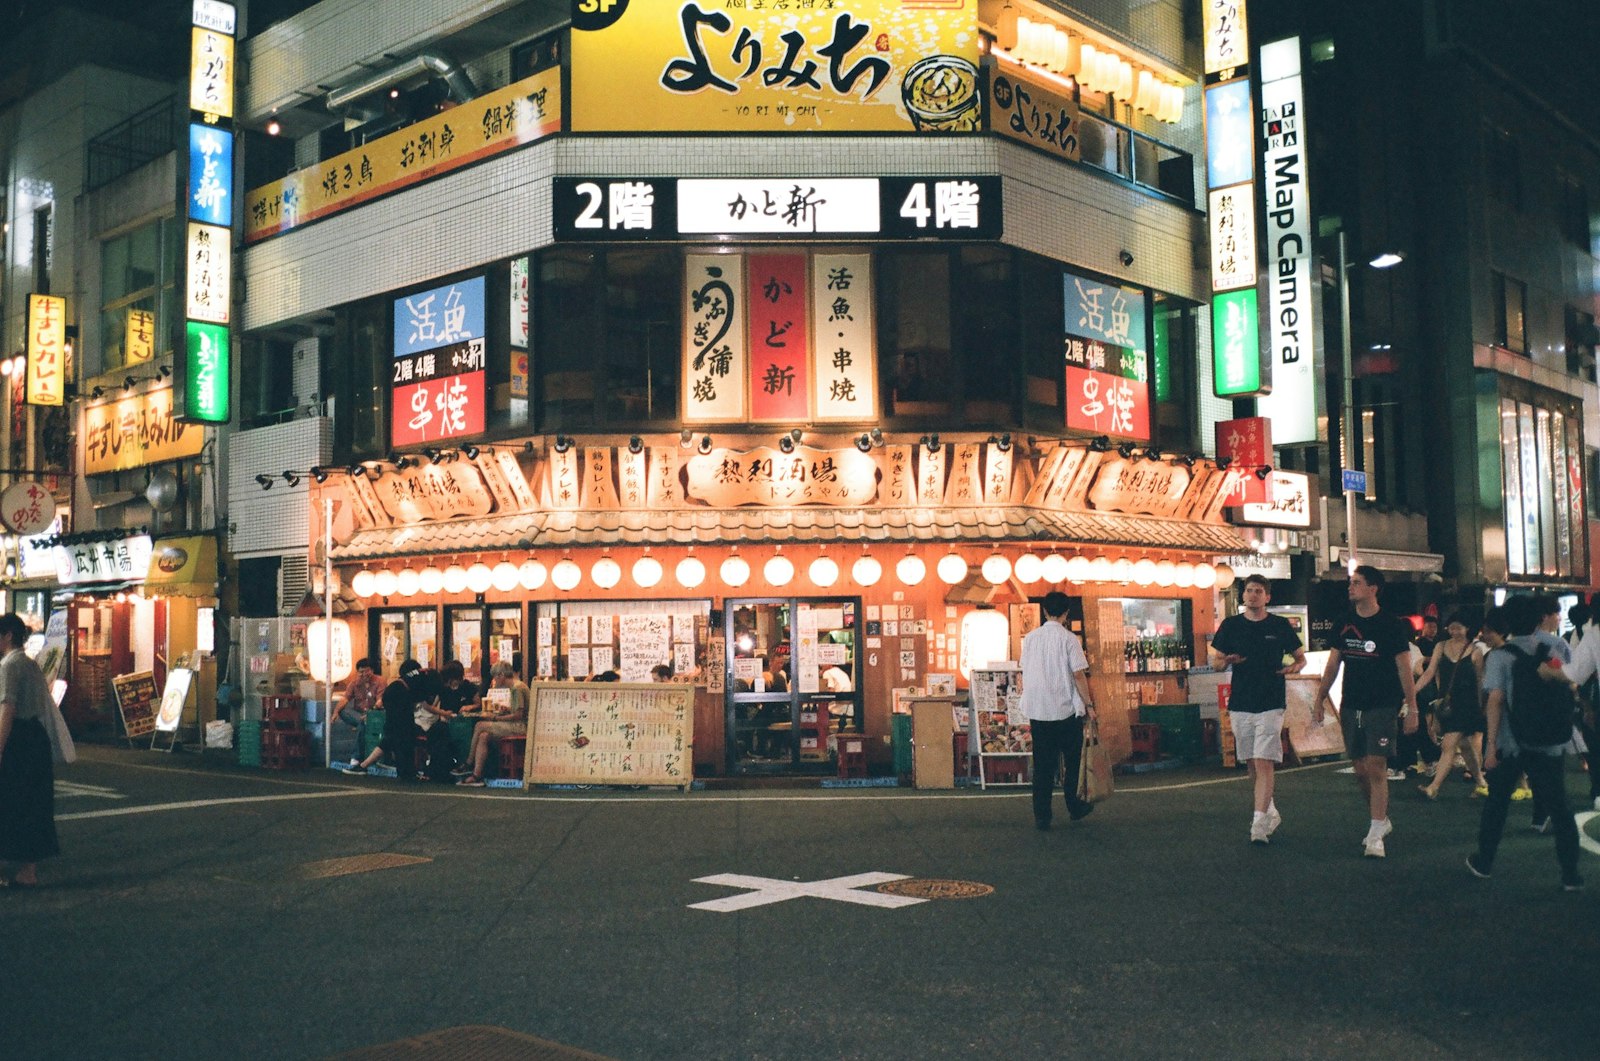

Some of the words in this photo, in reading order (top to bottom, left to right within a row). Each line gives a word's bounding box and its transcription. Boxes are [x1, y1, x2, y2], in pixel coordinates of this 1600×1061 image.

[203, 34, 223, 100] よりみち
[662, 3, 890, 99] よりみち
[1219, 68, 1236, 81] 3F
[735, 106, 752, 116] YO
[756, 106, 769, 116] RI
[776, 106, 789, 116] MI
[796, 106, 817, 116] CHI
[995, 84, 1010, 101] 3F
[204, 112, 219, 124] 3F
[1010, 84, 1077, 155] よりみち
[400, 124, 455, 168] お刺身
[323, 155, 374, 198] 焼き鳥
[574, 181, 655, 231] 2階
[900, 181, 980, 230] 4階
[405, 286, 473, 345] 活魚
[762, 276, 796, 397] かど新
[827, 266, 857, 402] 活魚・串焼
[1074, 278, 1136, 347] 活魚
[393, 359, 413, 383] 2階
[415, 354, 436, 378] 4階
[1065, 339, 1084, 364] 2階
[1086, 344, 1106, 368] 4階
[408, 377, 469, 441] 串焼
[1081, 370, 1135, 434] 串焼
[714, 457, 839, 484] 熱烈酒場
[1226, 428, 1251, 502] かど新
[13, 508, 30, 532] めん
[75, 545, 131, 575] 広州市場
